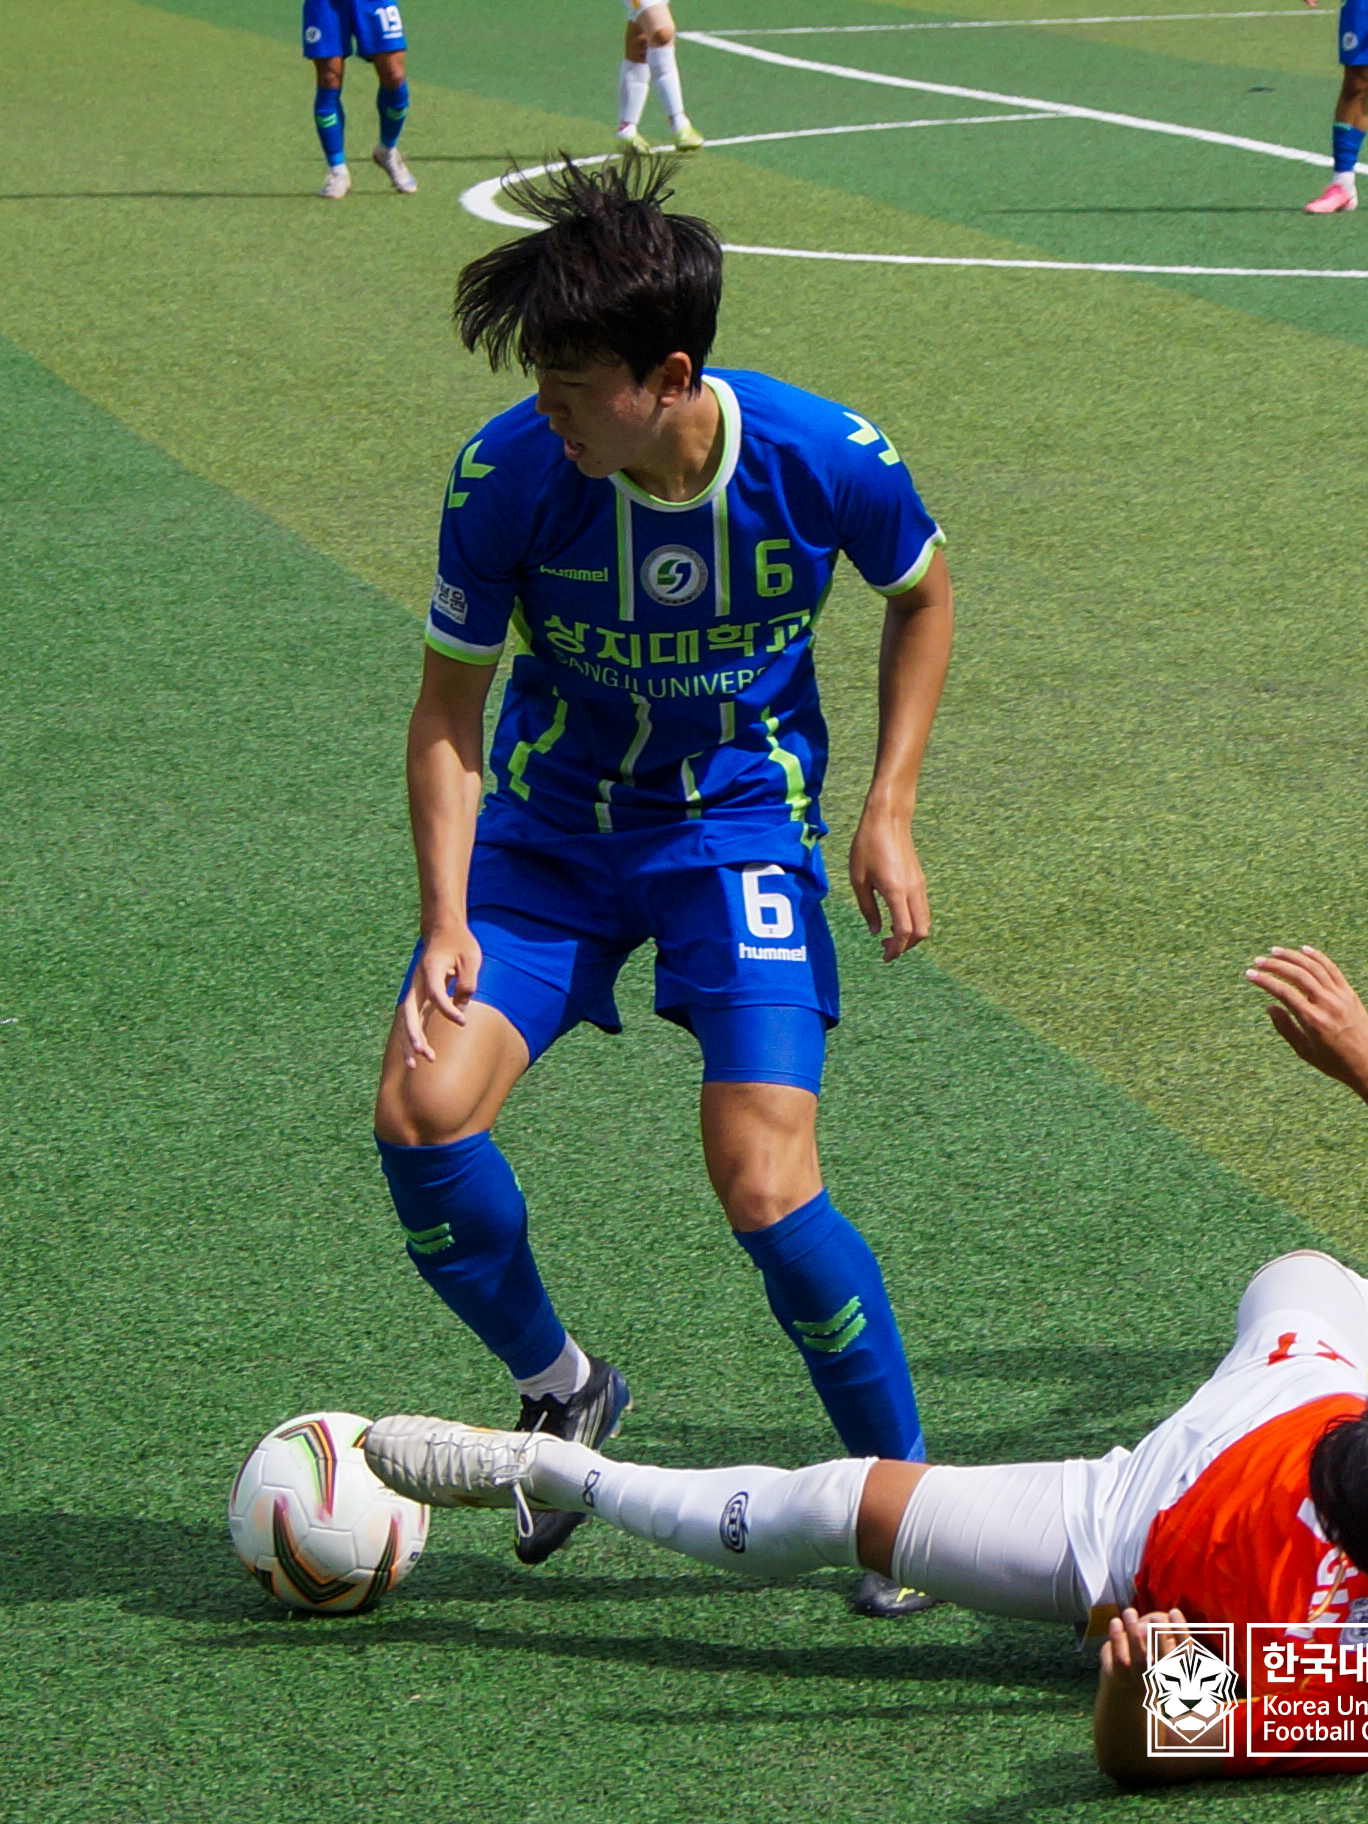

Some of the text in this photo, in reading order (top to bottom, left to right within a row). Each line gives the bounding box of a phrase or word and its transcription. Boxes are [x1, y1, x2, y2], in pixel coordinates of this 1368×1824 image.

[374, 5, 403, 32] 19
[539, 564, 609, 582] hummel
[755, 538, 794, 598] 6
[543, 608, 811, 669] 상지대학교
[648, 665, 767, 699] UNIVER
[741, 862, 794, 939] 6
[738, 942, 807, 962] hummel
